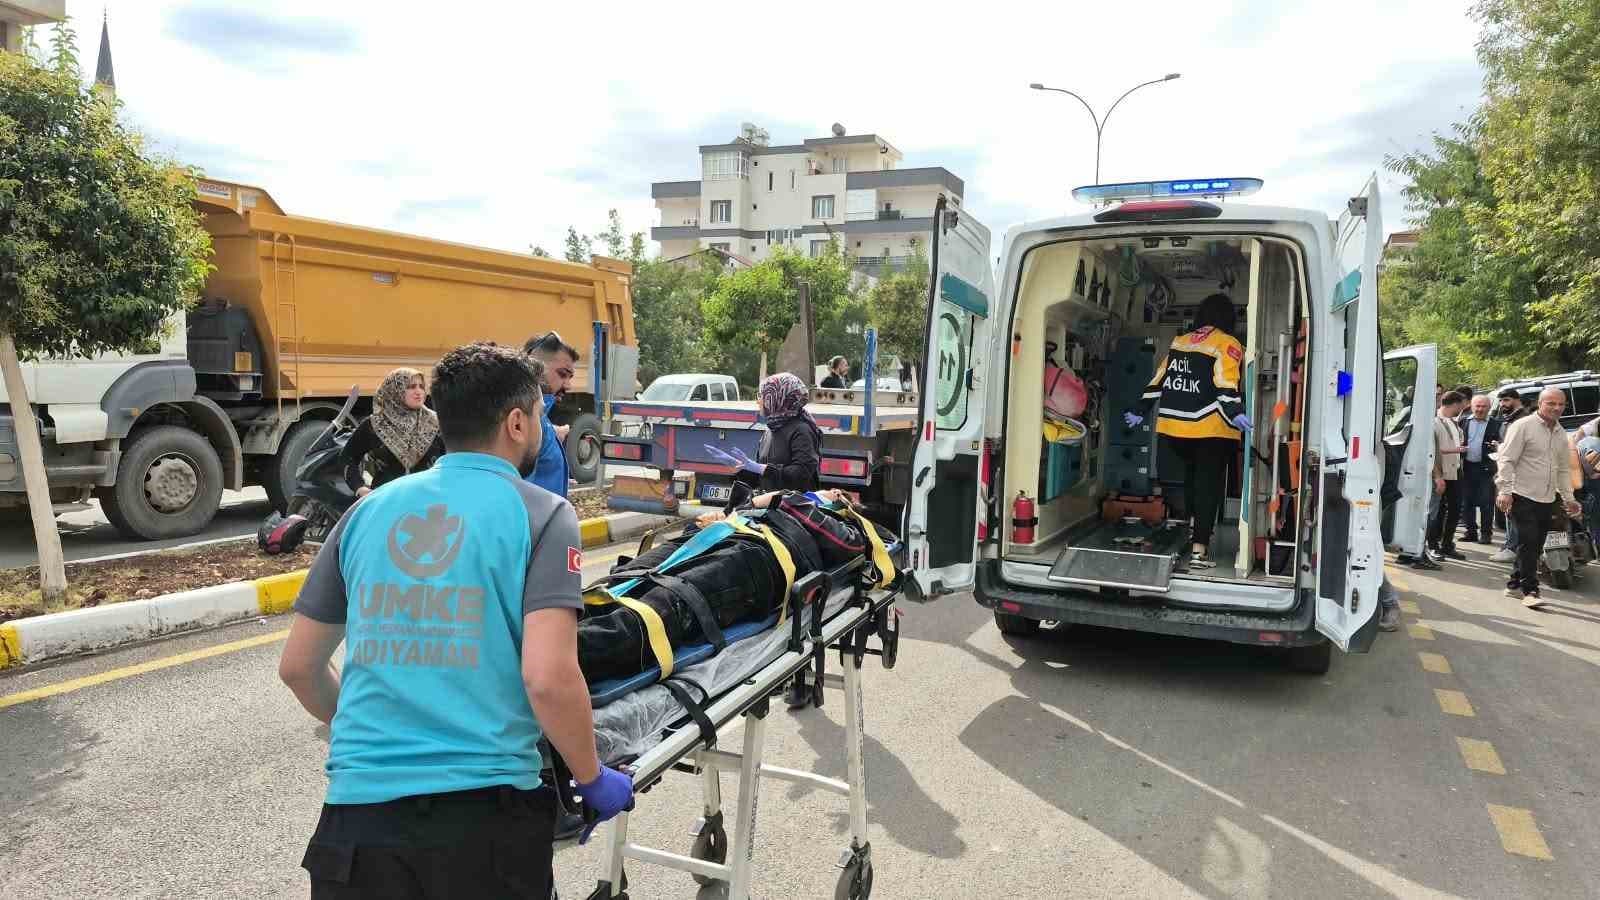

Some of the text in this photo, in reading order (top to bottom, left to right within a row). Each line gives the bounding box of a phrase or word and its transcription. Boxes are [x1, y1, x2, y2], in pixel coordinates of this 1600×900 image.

[1167, 357, 1192, 374] ACİL
[709, 487, 720, 498] 06
[359, 583, 485, 622] UMKE
[352, 638, 480, 668] ADIYAMAN
